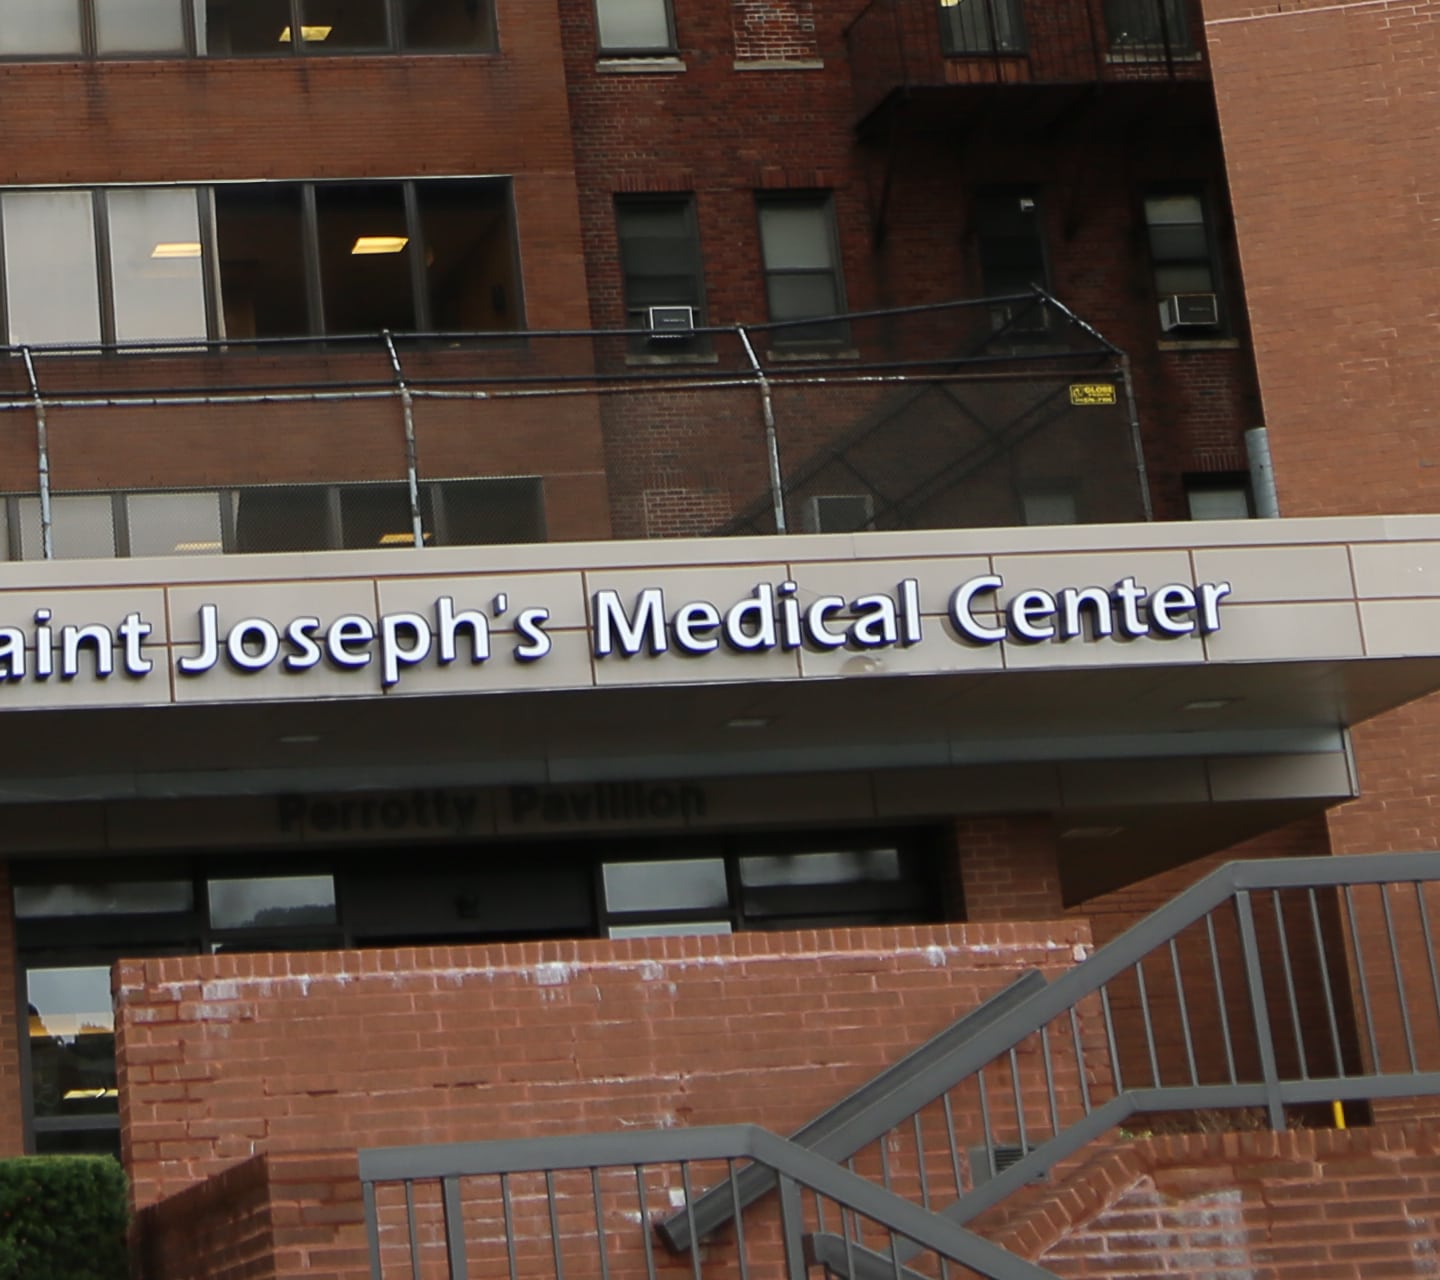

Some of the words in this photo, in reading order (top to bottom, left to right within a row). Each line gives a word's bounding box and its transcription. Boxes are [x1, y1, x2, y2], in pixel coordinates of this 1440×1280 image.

[178, 592, 552, 687] Joseph's
[592, 578, 921, 657] Medical
[948, 574, 1231, 642] Center
